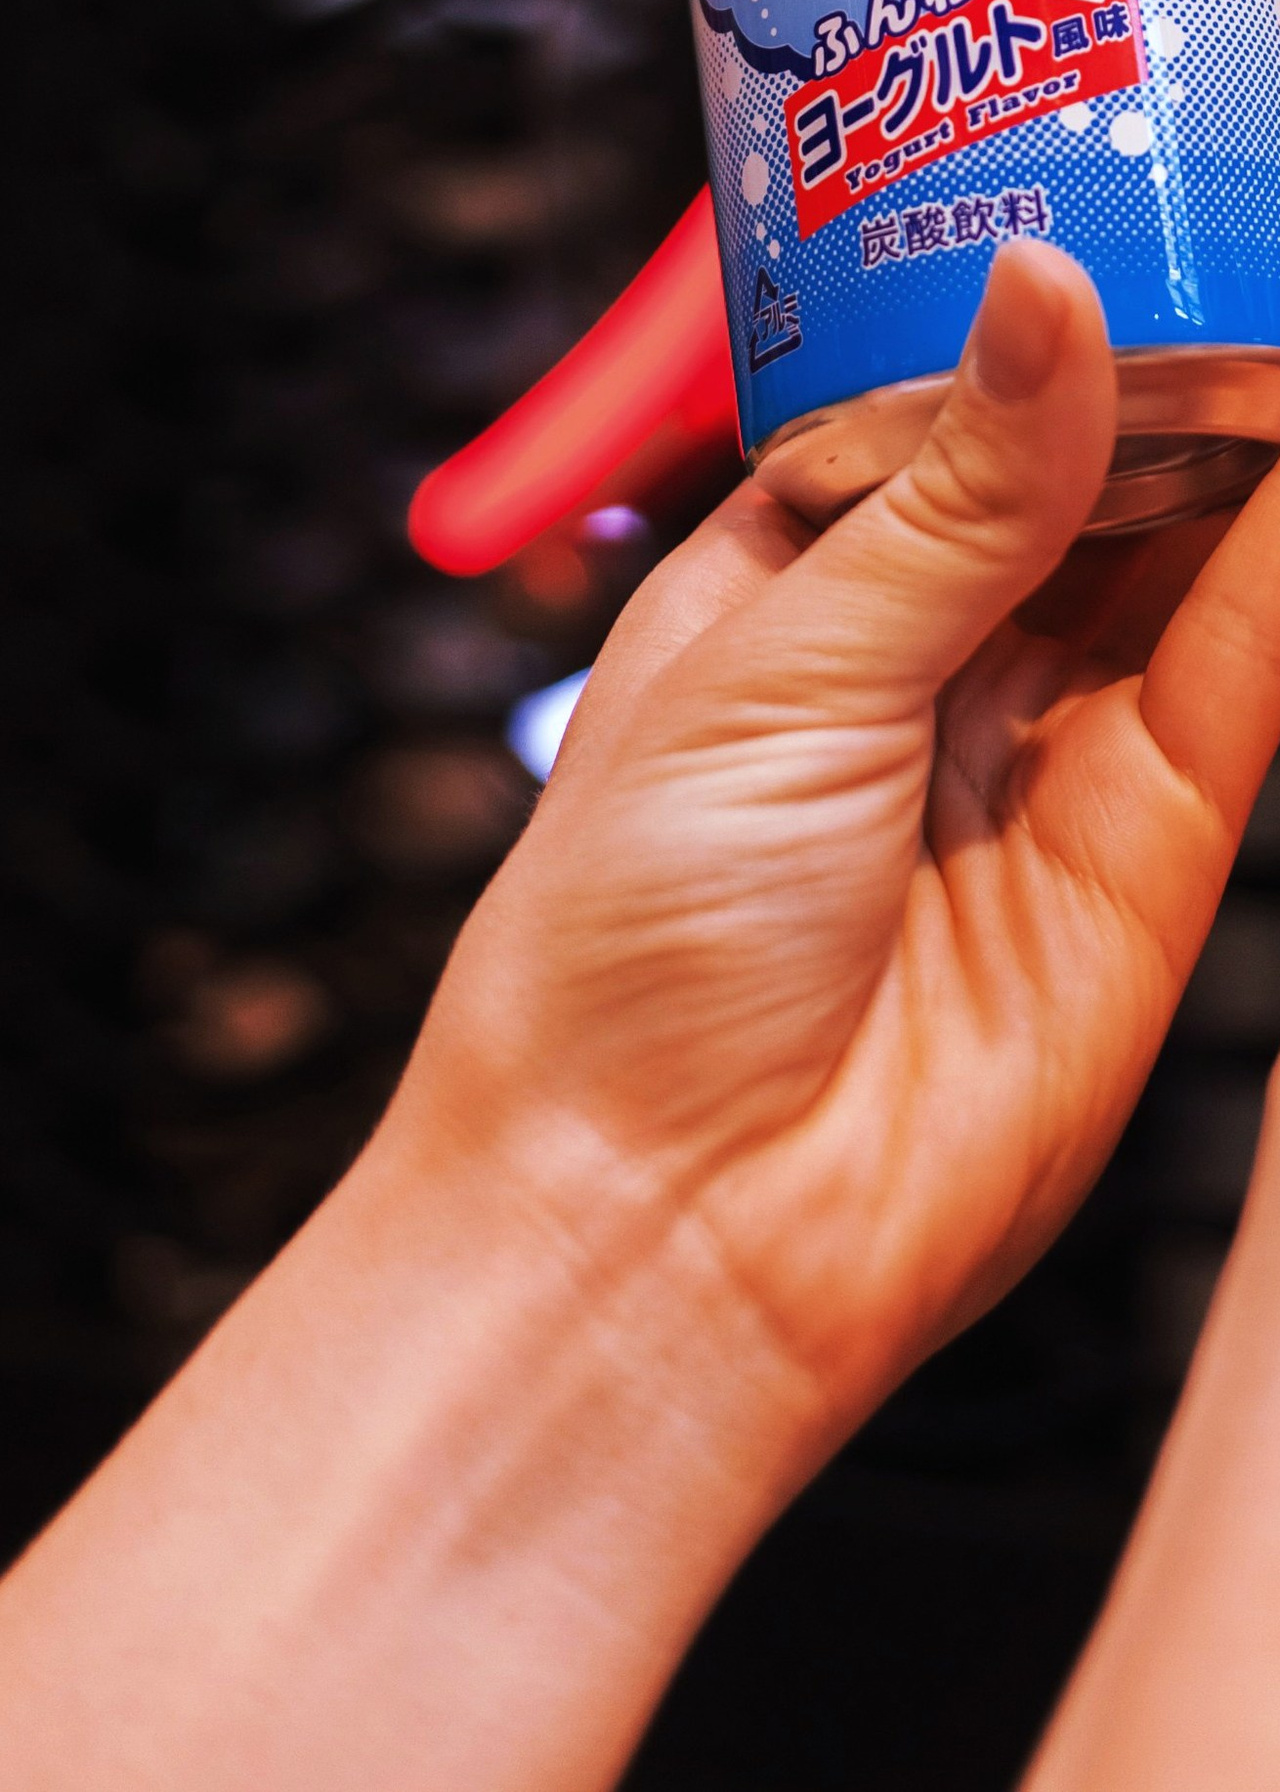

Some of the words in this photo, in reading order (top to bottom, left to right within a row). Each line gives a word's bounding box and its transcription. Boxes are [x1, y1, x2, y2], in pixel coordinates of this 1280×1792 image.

[846, 121, 953, 191] Yogurt
[968, 71, 1079, 128] Flavor
[861, 188, 1050, 267] 炭酸飲料
